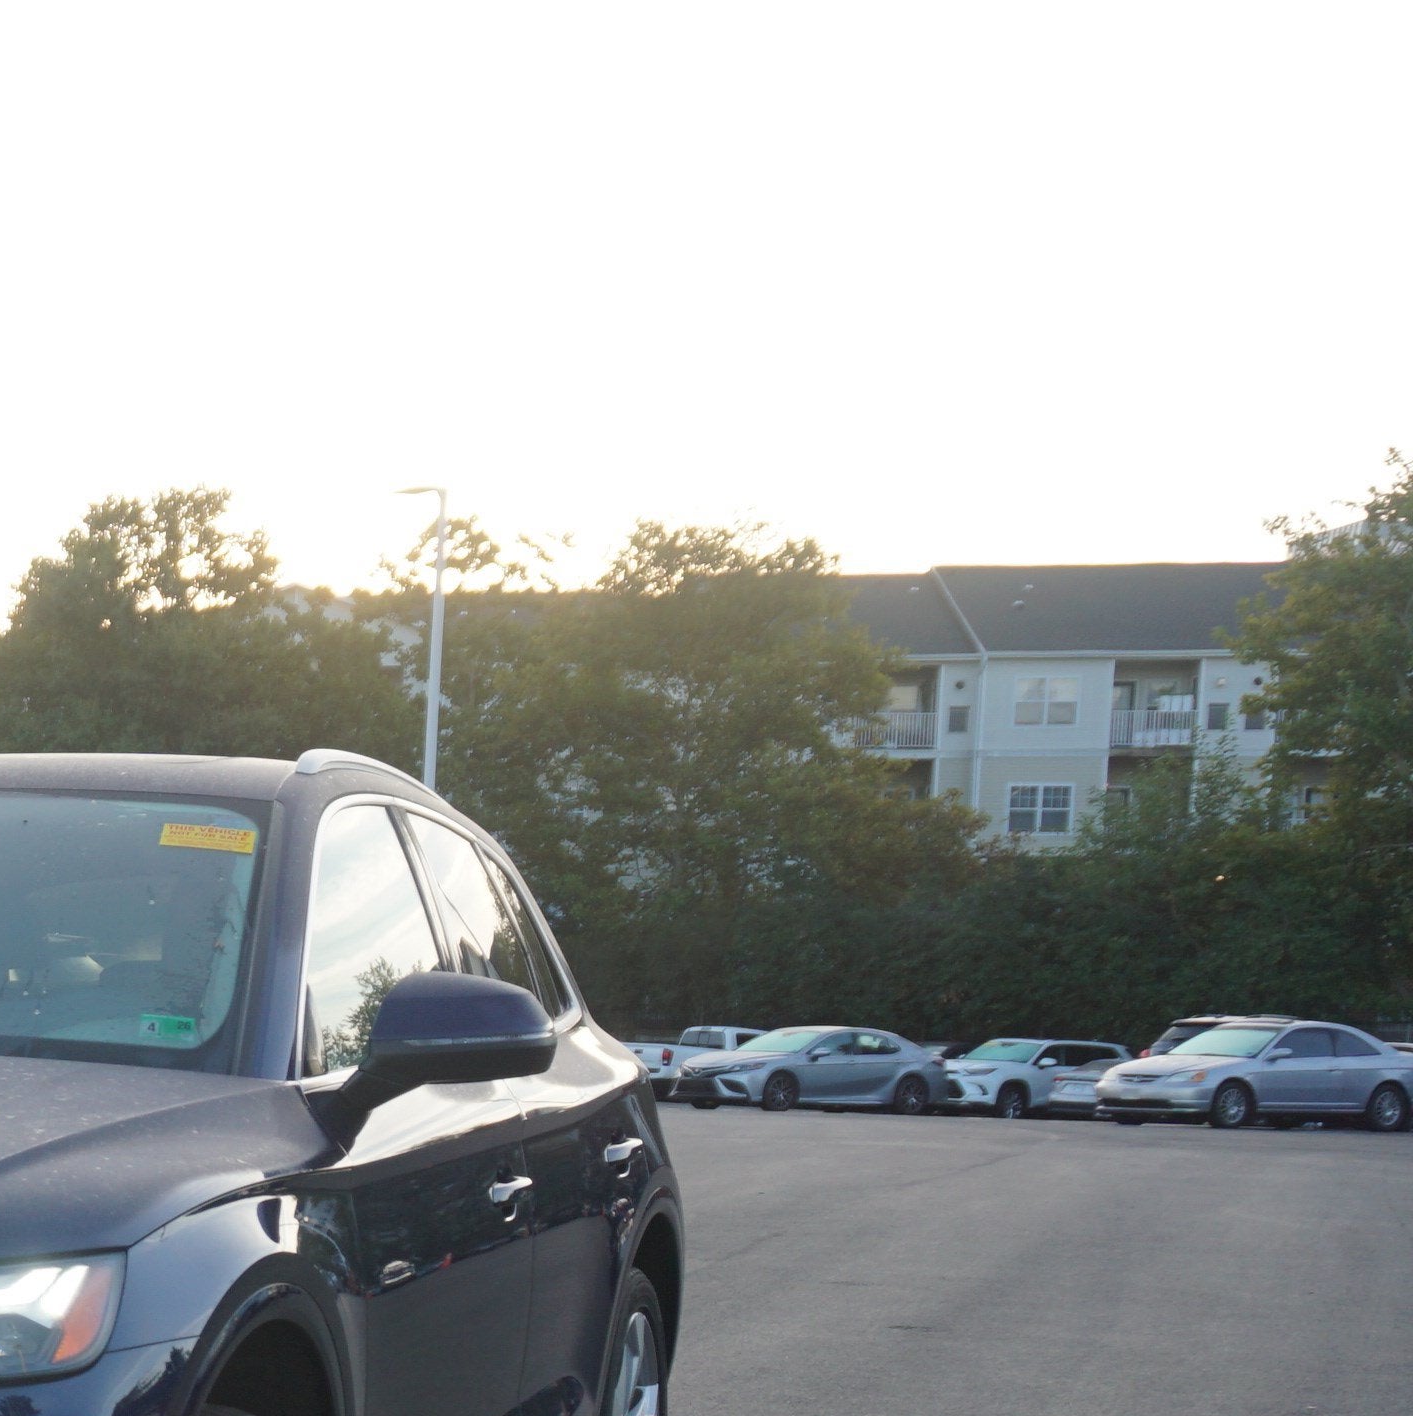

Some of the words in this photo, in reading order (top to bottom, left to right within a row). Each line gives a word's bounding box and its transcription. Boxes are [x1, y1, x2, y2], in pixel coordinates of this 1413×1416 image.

[168, 824, 195, 832] THIS
[200, 826, 249, 836] VEHICLE
[147, 1022, 156, 1032] 4
